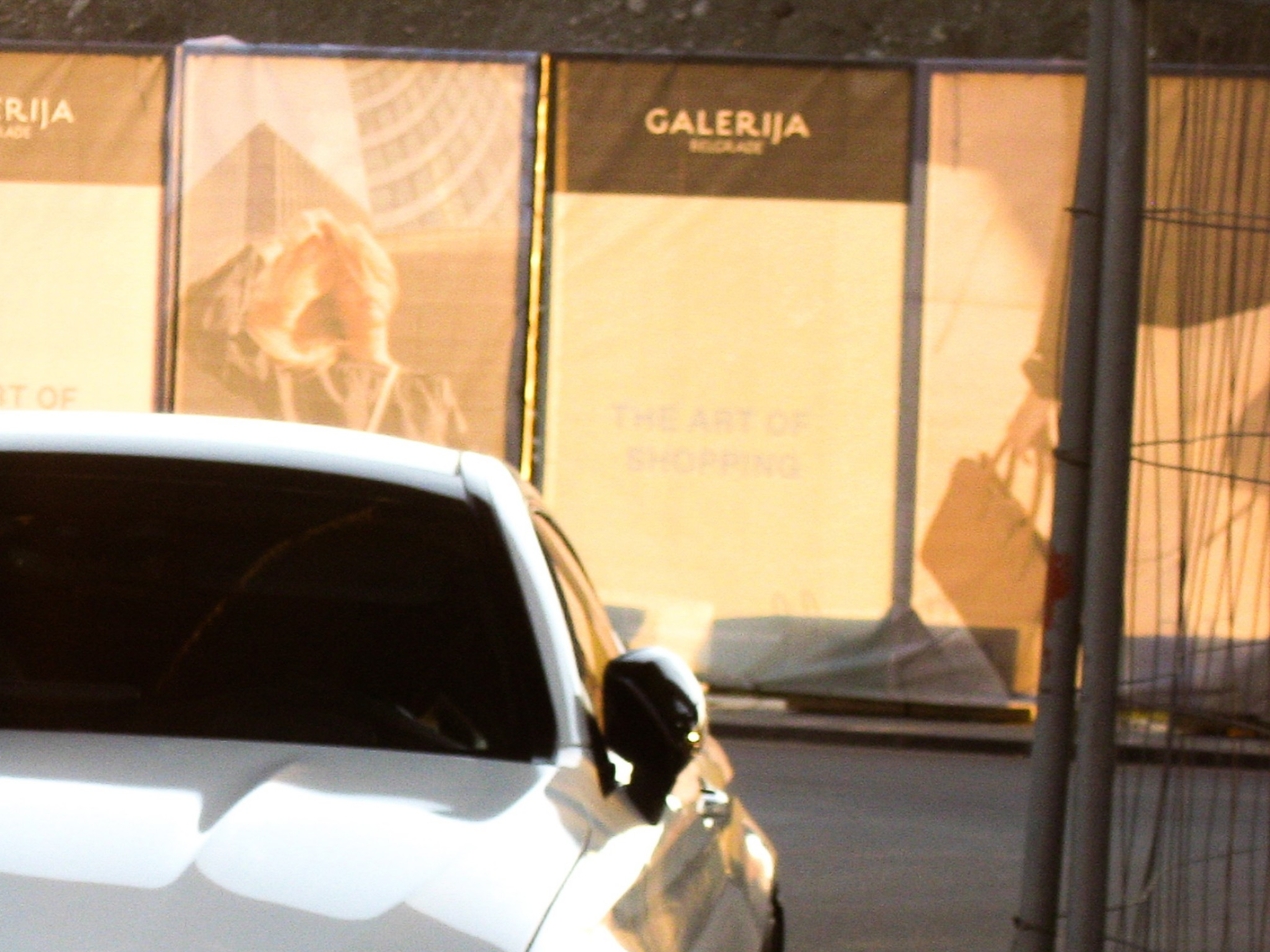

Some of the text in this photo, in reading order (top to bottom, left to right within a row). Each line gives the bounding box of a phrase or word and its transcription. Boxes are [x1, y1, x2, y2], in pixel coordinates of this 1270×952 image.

[645, 106, 811, 145] GALERIJA
[36, 385, 79, 411] OF
[611, 403, 678, 431] THE
[687, 407, 754, 434] ART
[627, 446, 802, 480] SHOPPING
